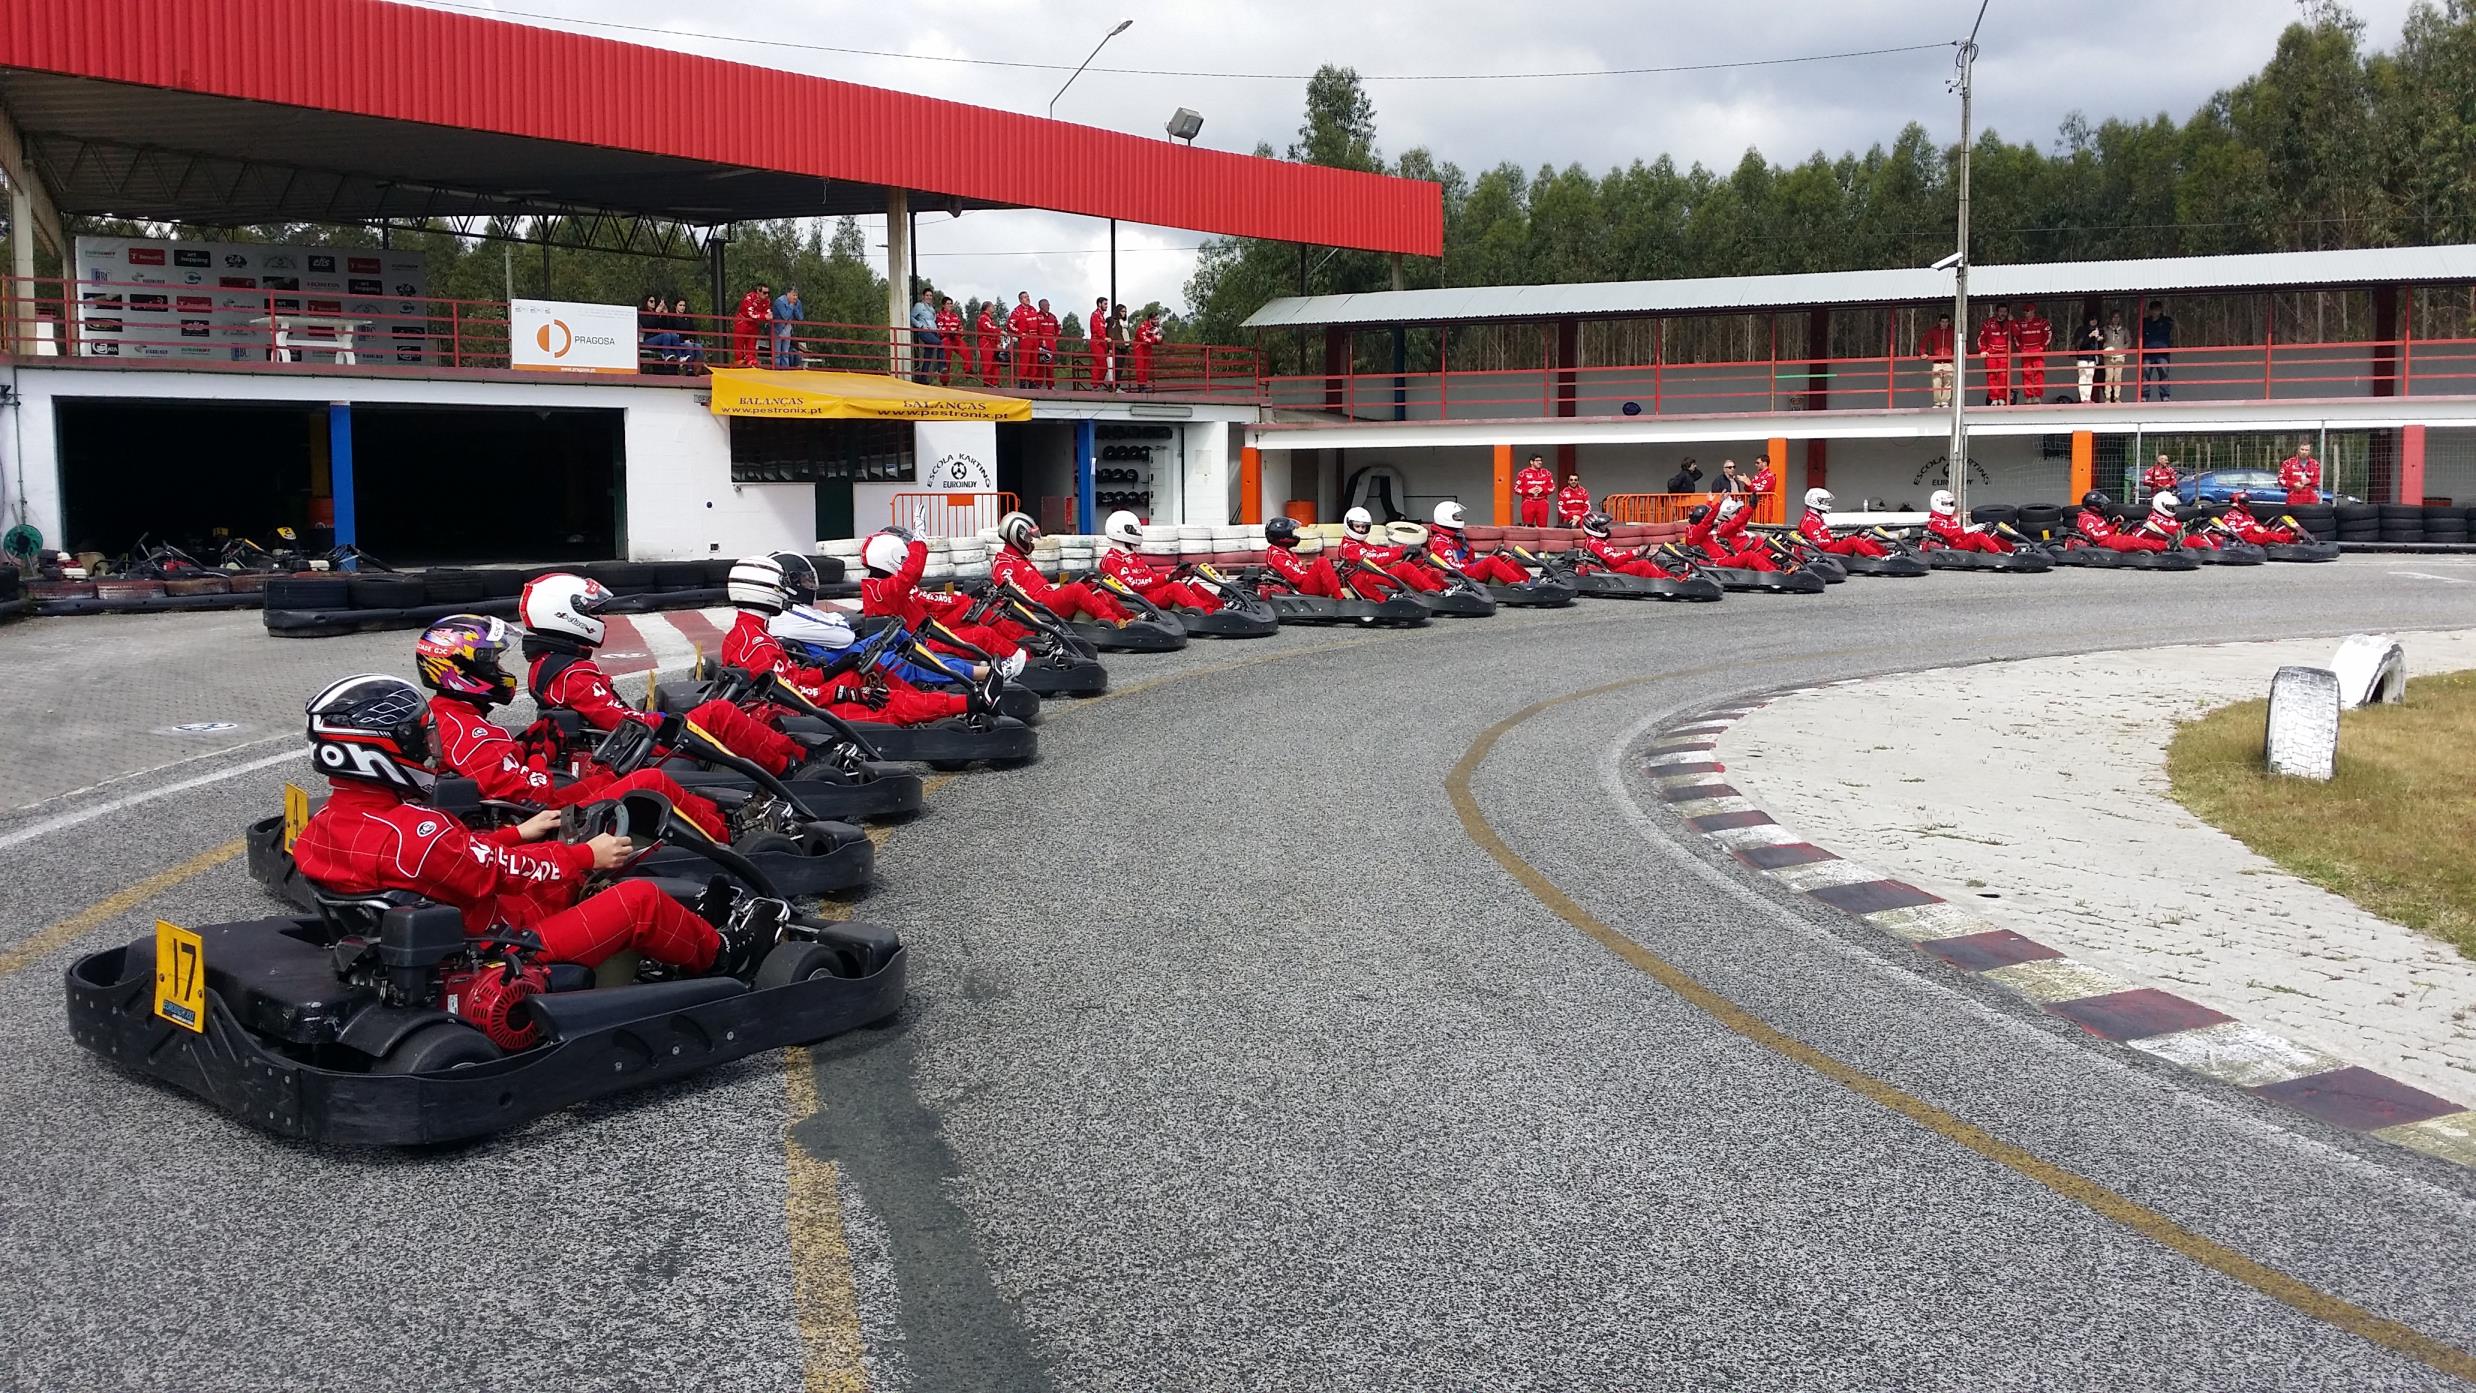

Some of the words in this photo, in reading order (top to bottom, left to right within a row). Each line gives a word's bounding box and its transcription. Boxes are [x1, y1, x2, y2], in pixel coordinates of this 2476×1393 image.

[574, 335, 616, 346] PRAGOSA
[739, 397, 805, 407] BALANÇAS
[721, 406, 823, 416] www.pestronix.pt
[877, 409, 1009, 420] www.pestronix.pt
[927, 454, 954, 488] ESCOLA
[959, 453, 991, 488] KARTING
[1913, 455, 1947, 486] ESCOLA
[942, 481, 978, 489] EUROINDY
[173, 937, 197, 1002] 17
